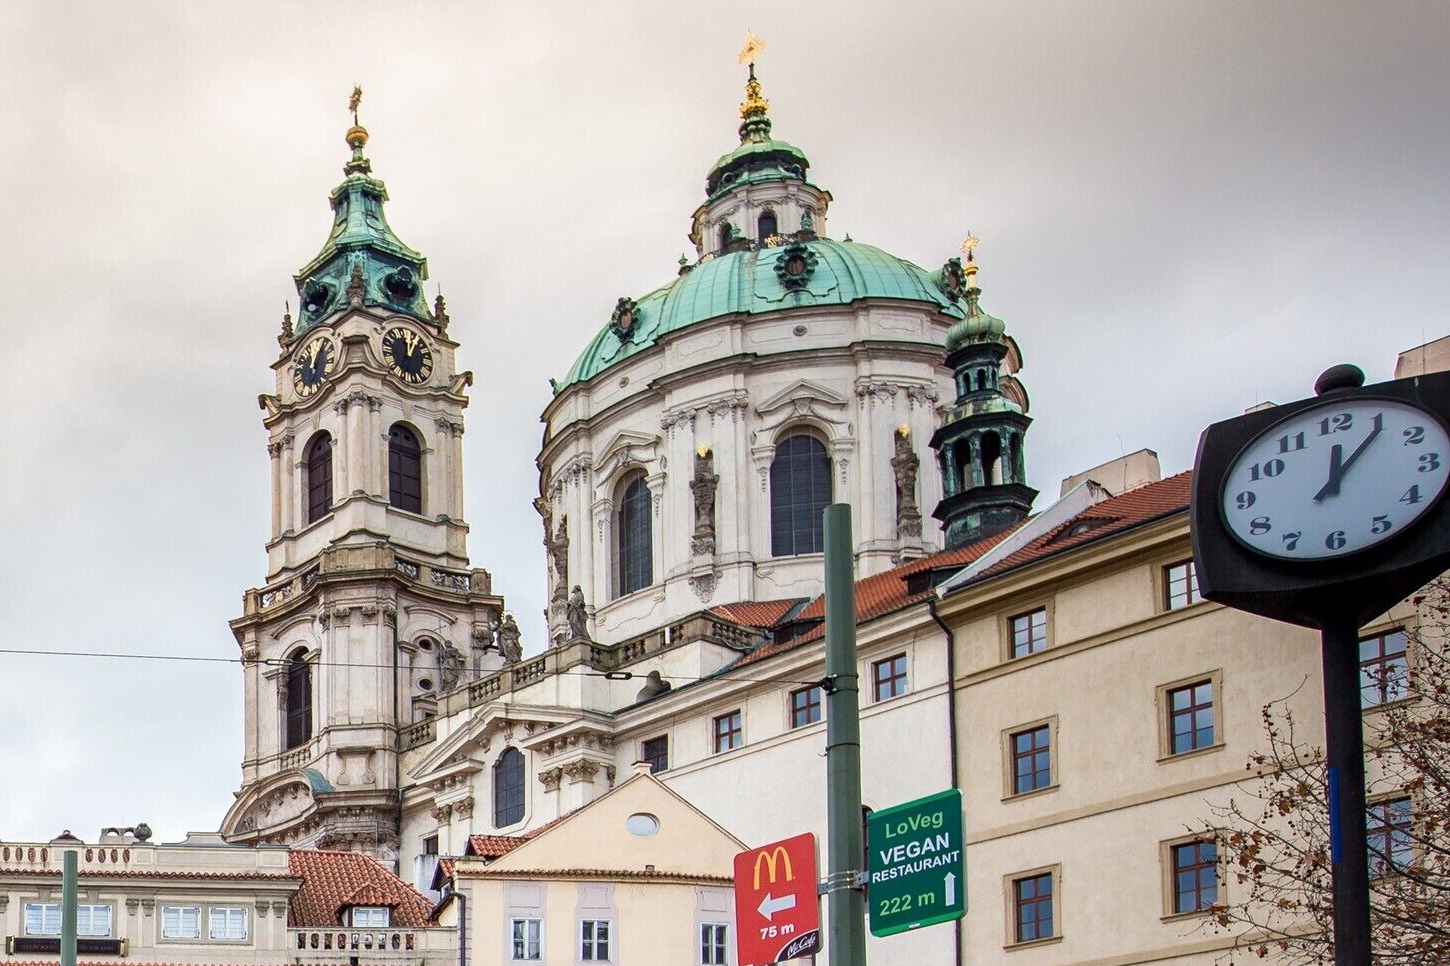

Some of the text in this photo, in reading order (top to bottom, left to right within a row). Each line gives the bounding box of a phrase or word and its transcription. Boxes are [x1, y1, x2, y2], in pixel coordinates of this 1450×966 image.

[1316, 413, 1353, 437] 12
[1277, 431, 1308, 454] 11
[1403, 426, 1425, 446] 2
[1247, 459, 1285, 483] 10
[1418, 452, 1440, 473] 3
[1235, 491, 1256, 510] 9
[1399, 484, 1423, 505] 4
[1250, 516, 1272, 536] 8
[1371, 514, 1392, 535] 5
[1282, 531, 1302, 551] 7
[1325, 530, 1347, 550] 6
[885, 811, 943, 839] LoVeg
[880, 832, 949, 865] VEGAN
[872, 850, 960, 883] RESTAURANT
[879, 892, 935, 916] 222 m
[760, 924, 794, 940] 75 m
